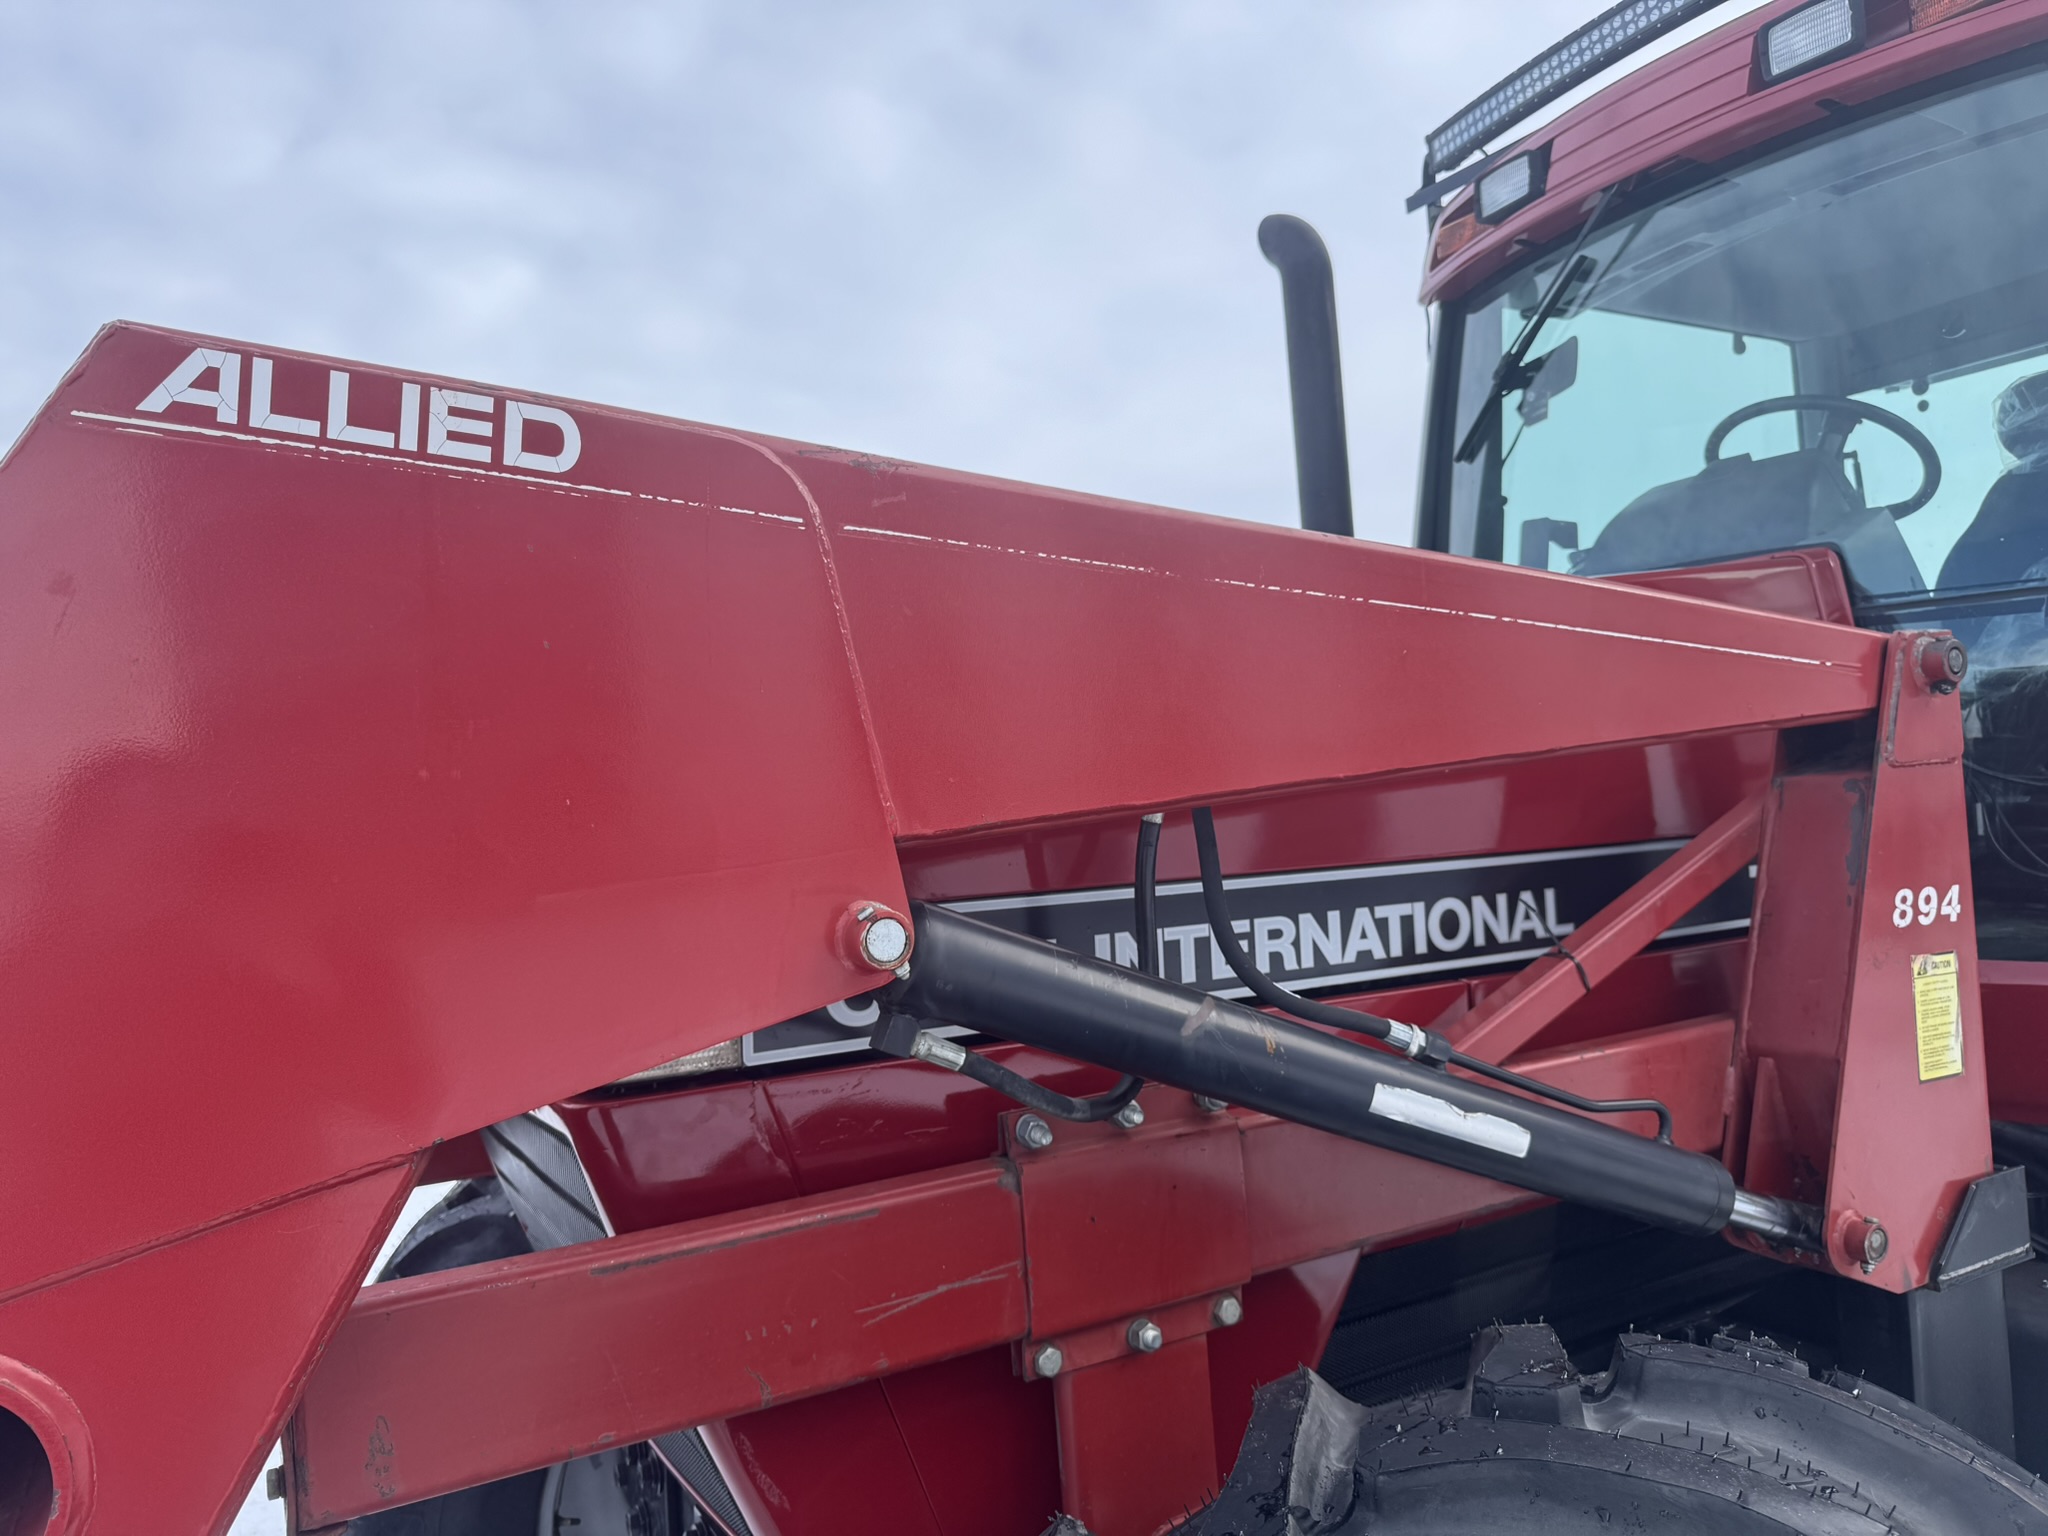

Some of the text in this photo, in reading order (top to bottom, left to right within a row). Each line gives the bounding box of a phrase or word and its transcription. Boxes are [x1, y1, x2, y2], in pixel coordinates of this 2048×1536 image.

[136, 347, 582, 473] ALLIED
[1892, 884, 1961, 928] 894
[1931, 959, 1951, 970] CAUTION
